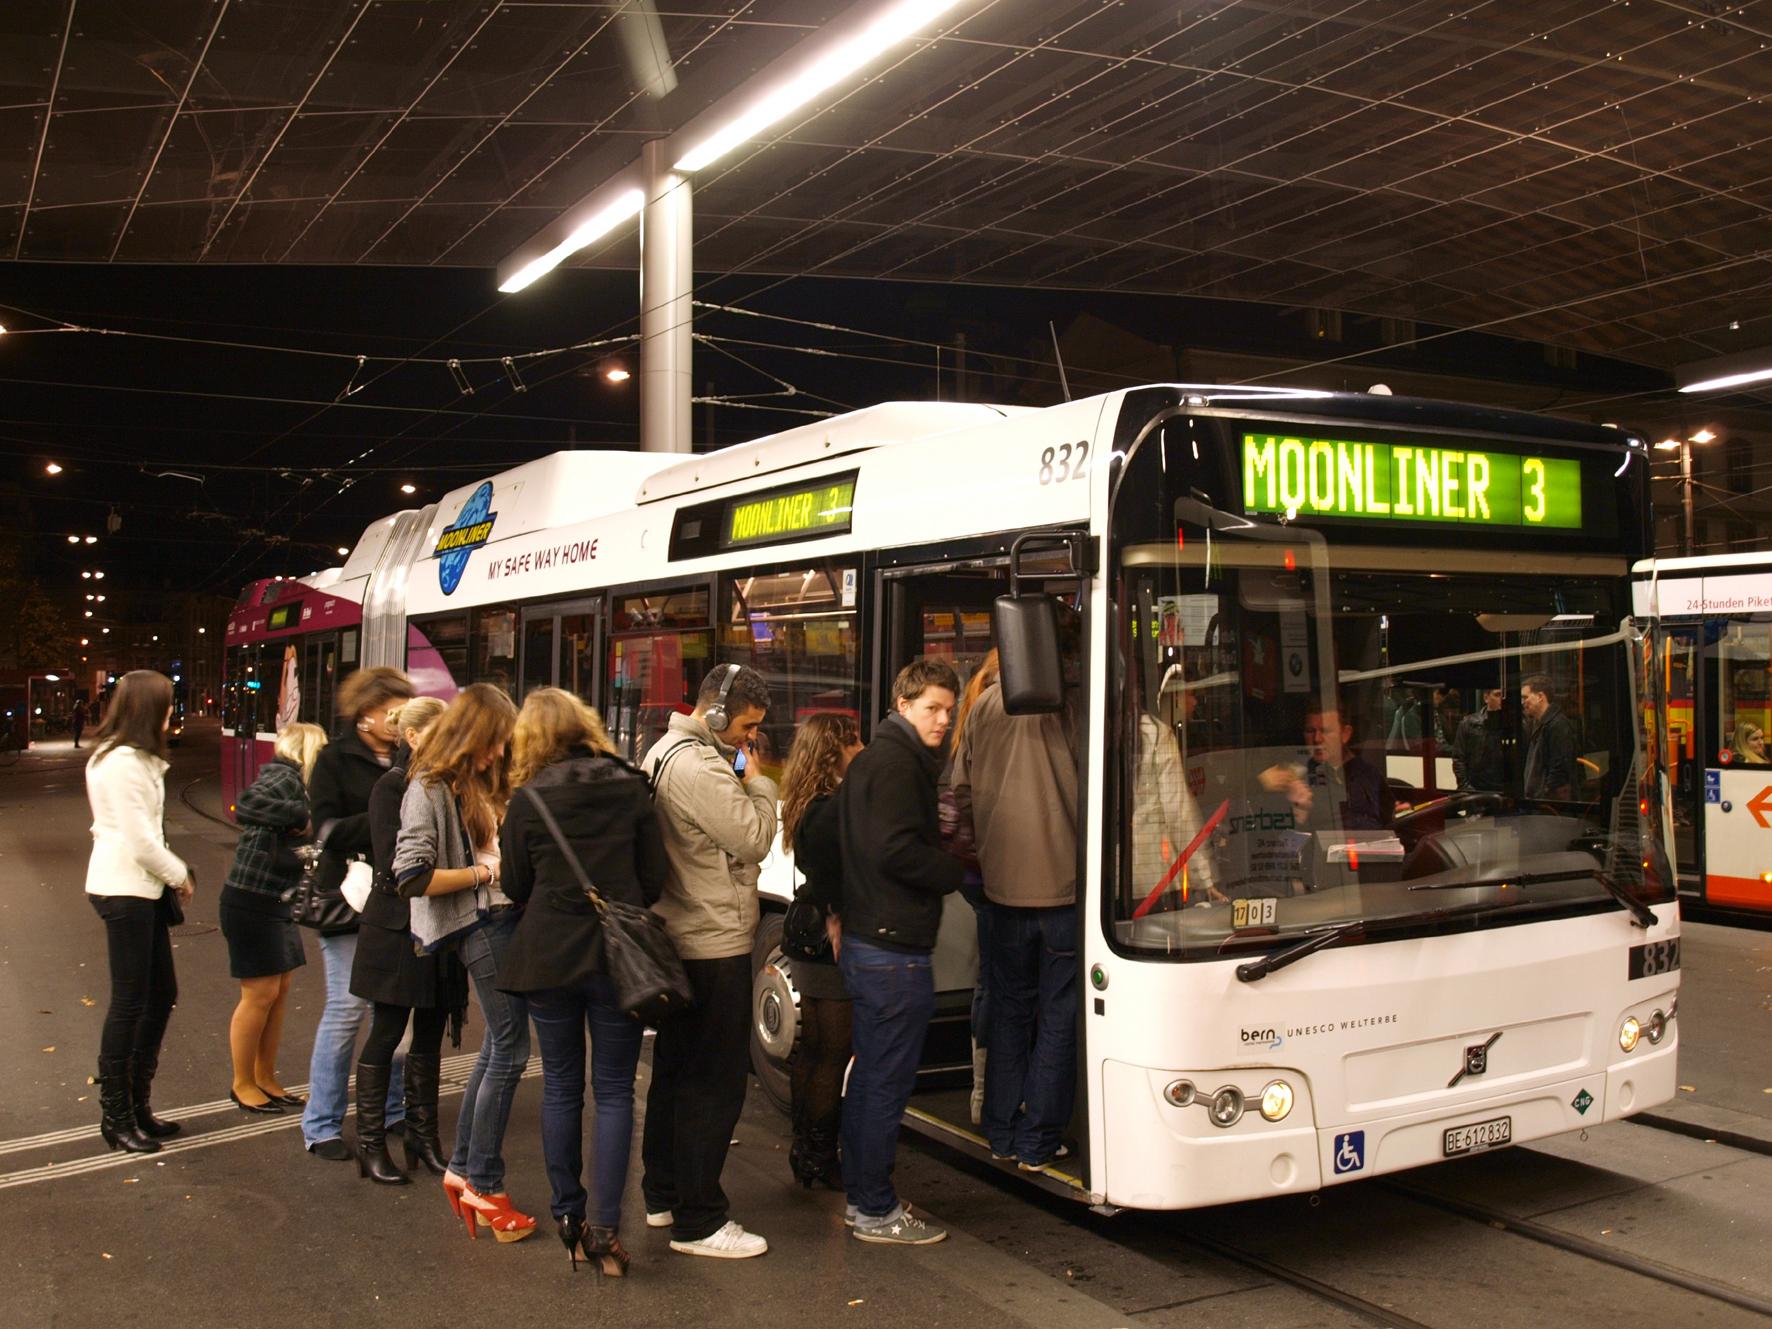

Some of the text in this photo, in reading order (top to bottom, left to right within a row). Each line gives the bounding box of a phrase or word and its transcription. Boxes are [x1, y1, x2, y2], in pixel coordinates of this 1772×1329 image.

[1039, 440, 1089, 485] 832
[1244, 436, 1545, 522] MOONLINER 3
[732, 487, 839, 539] MOONLINER 3
[437, 521, 492, 551] MOONLINER
[488, 538, 599, 580] MY SAFE WAY HOME
[1687, 596, 1744, 610] 24-Stunden
[1643, 938, 1680, 977] 832
[1241, 1014, 1398, 1041] bern UNESCO WELTERBE
[1574, 1096, 1591, 1108] CNG
